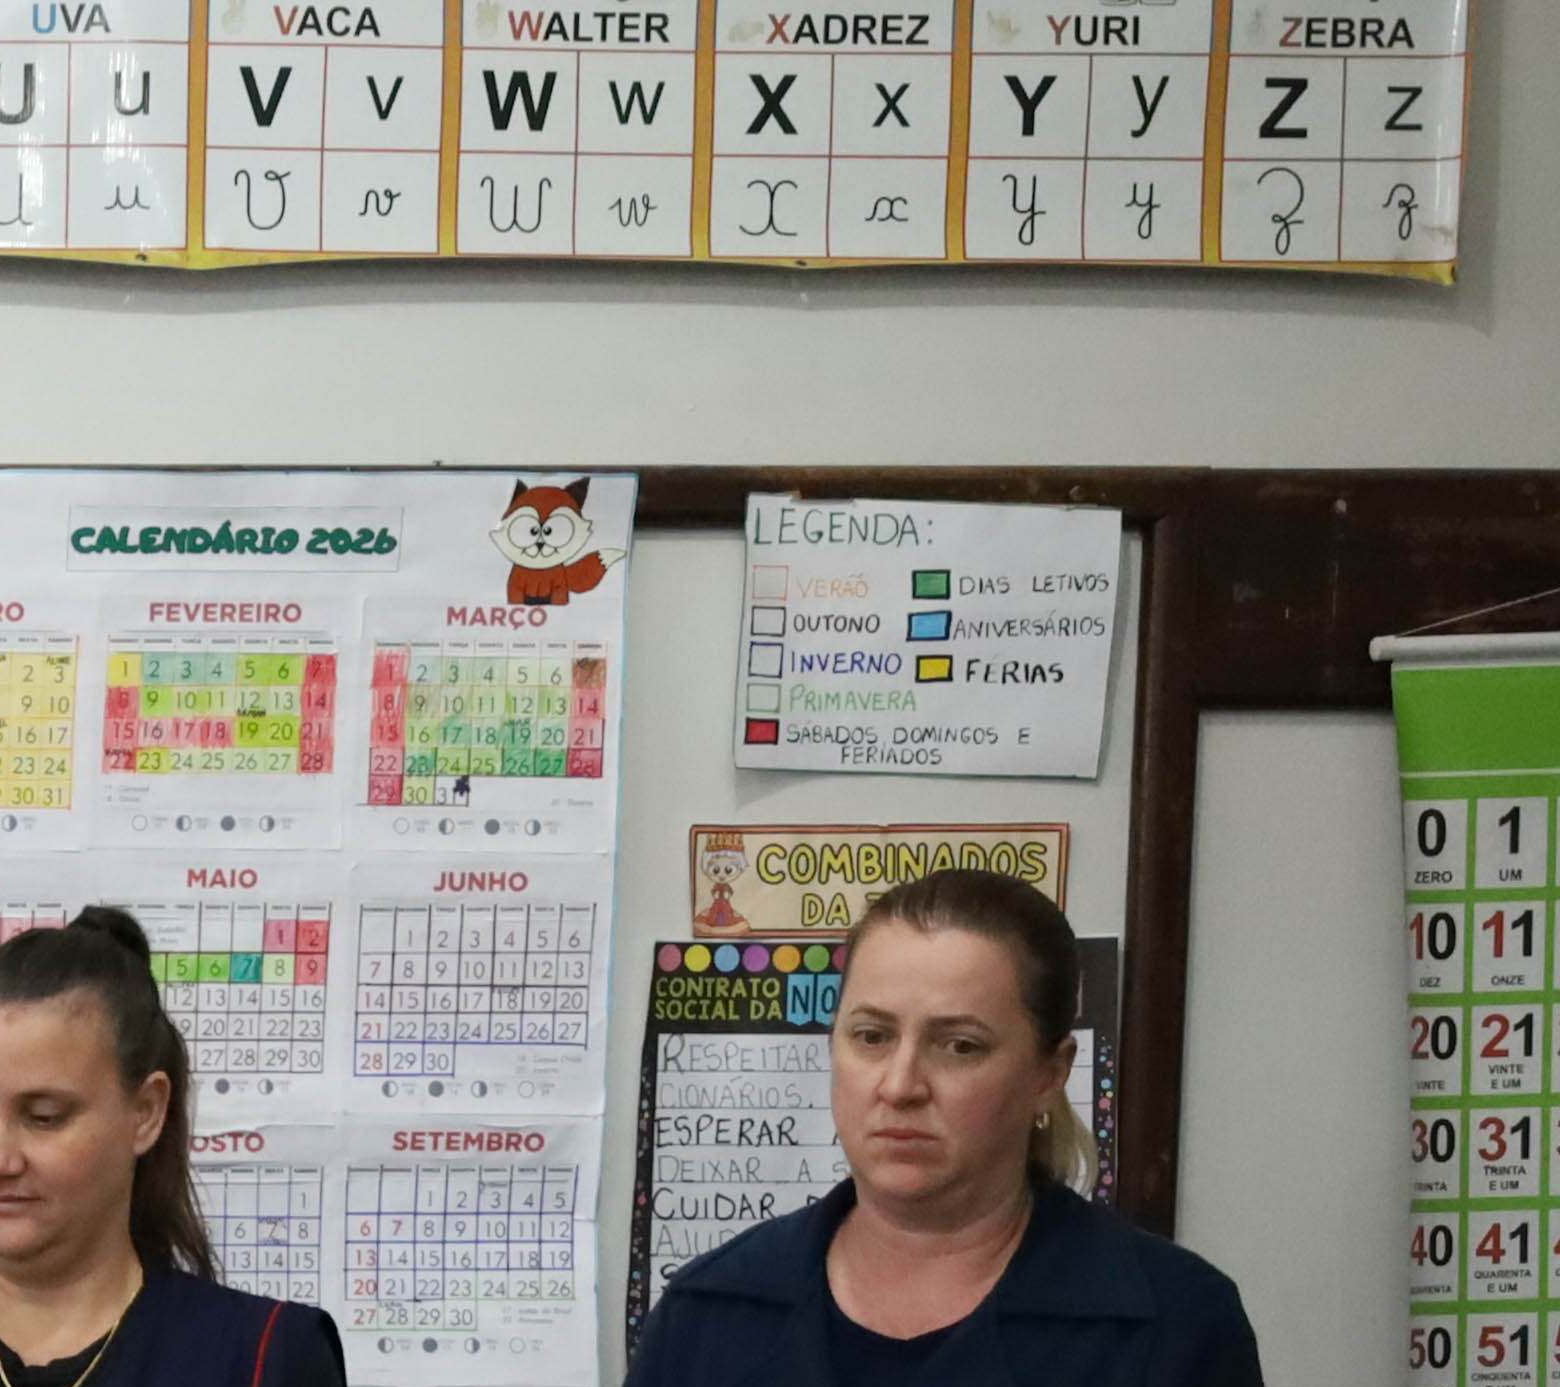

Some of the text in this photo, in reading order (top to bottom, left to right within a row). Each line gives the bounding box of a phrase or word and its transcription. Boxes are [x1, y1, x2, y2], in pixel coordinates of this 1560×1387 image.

[33, 3, 110, 33] UVA
[274, 6, 380, 37] VACA
[509, 12, 669, 43] WALTER
[768, 14, 929, 45] XADREZ
[1048, 16, 1139, 46] YURI
[1280, 17, 1414, 48] ZEBRA
[240, 66, 292, 127] V
[483, 70, 664, 131] W w
[746, 75, 909, 134] X x
[1004, 75, 1169, 138] Y y
[1259, 78, 1422, 138] Z z
[71, 520, 397, 555] CALENDÁRIO 2026
[753, 507, 933, 548] LEGENDA:
[960, 573, 1109, 595] DIAS LETIVOS
[150, 602, 302, 623] FEVEREIRO
[446, 602, 547, 629] MARÇO
[793, 614, 880, 634] OUTONO
[953, 611, 1105, 637] ANIVERSÁRIOS
[792, 651, 902, 675] INVERNO
[966, 655, 1064, 685] FÉRIAS
[790, 683, 916, 712] PRIMAVERA
[893, 726, 998, 745] DOMINGOS
[1018, 728, 1030, 744] E
[1418, 808, 1446, 857] 0
[1499, 806, 1520, 853] 1
[187, 869, 257, 888] MAIO
[434, 872, 528, 892] JUNHO
[1415, 871, 1452, 884] ZERO
[1499, 869, 1522, 881] UM
[801, 893, 850, 926] DA
[1410, 912, 1456, 960] 10
[1483, 910, 1533, 957] 11
[655, 977, 781, 998] CONTRATO
[1492, 975, 1525, 985] ONZE
[655, 1000, 782, 1020] SOCIAL DA
[1411, 1016, 1457, 1060] 20
[1481, 1013, 1533, 1057] 21
[663, 1034, 822, 1074] RESPEITAR
[393, 1131, 544, 1152] SETEMBRO
[655, 1114, 798, 1148] ESPERAR
[1412, 1118, 1455, 1162] 30
[1478, 1116, 1530, 1160] 31
[658, 1155, 812, 1182] DEIXAR A
[651, 1187, 775, 1221] CUIDAR
[1410, 1225, 1453, 1266] 40
[1476, 1222, 1528, 1264] 41
[1410, 1327, 1451, 1369] 50
[1477, 1325, 1529, 1367] 51
